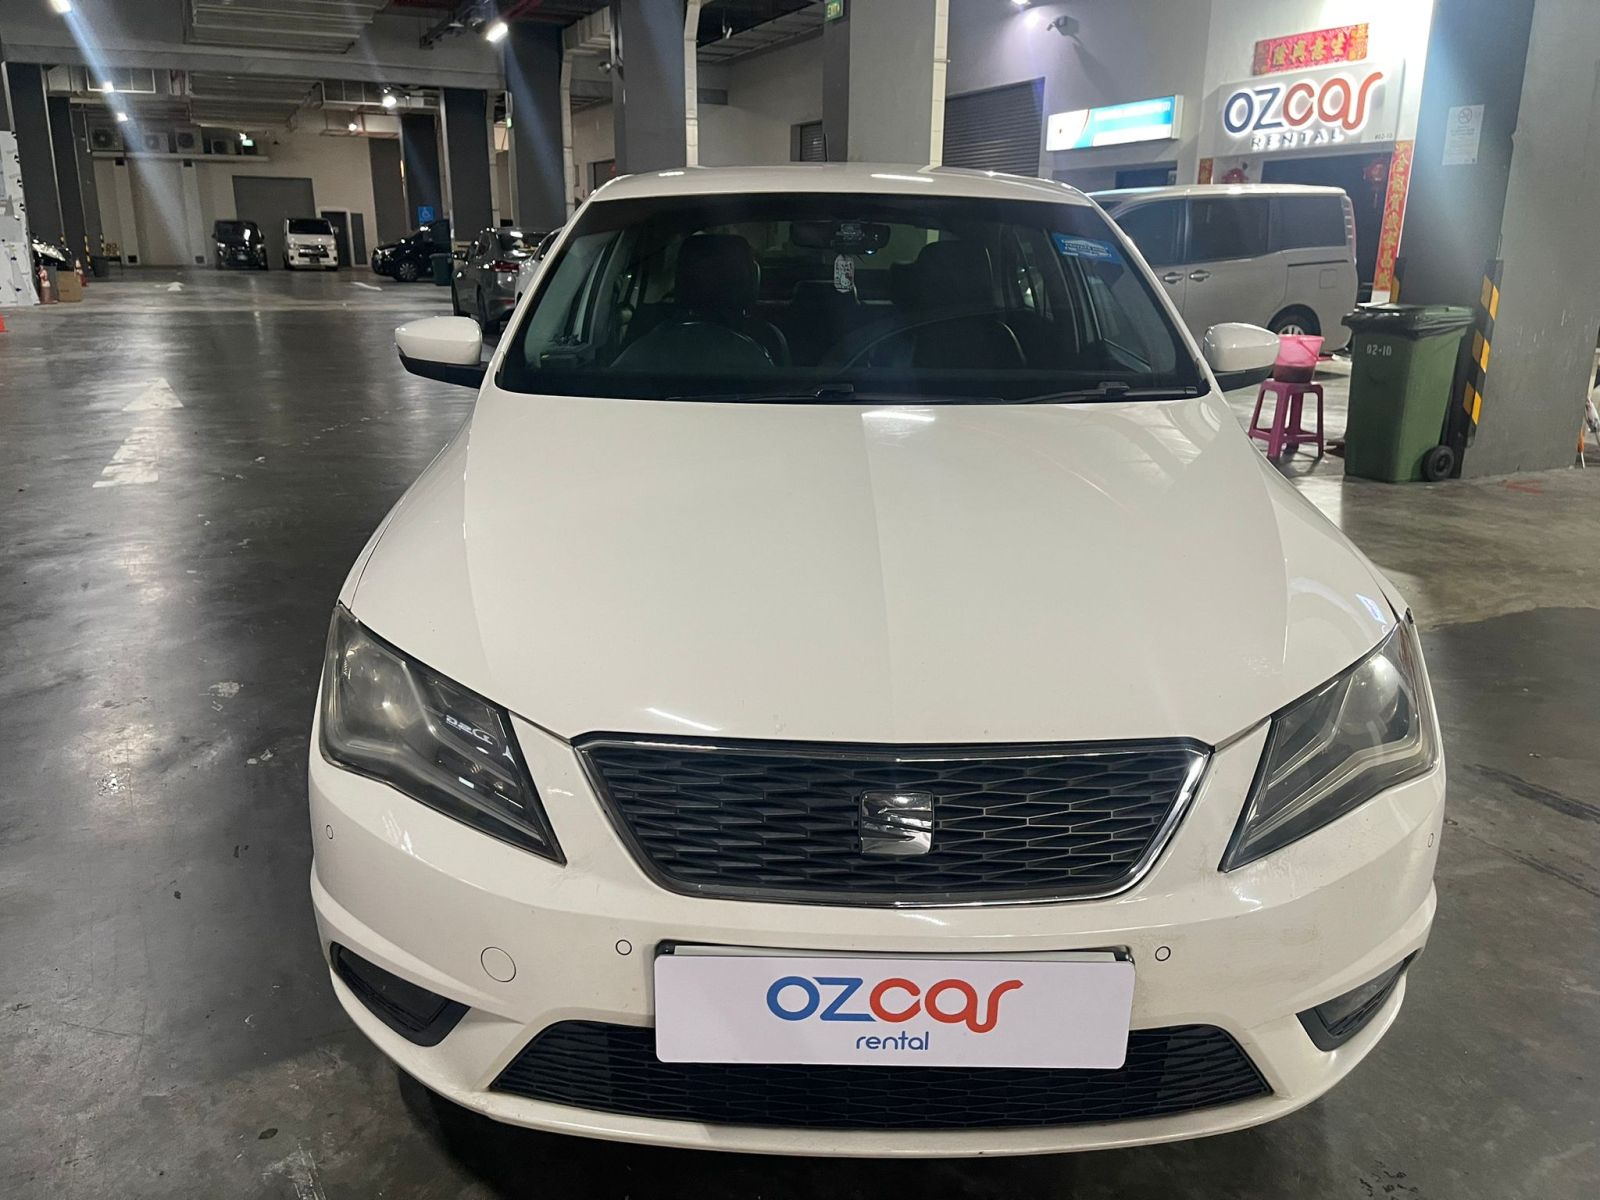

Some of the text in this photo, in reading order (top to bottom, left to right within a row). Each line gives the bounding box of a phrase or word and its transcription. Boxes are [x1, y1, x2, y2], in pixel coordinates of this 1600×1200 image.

[1251, 127, 1344, 152] RENTAL
[1367, 344, 1392, 356] 02-10
[856, 1031, 928, 1051] rental
